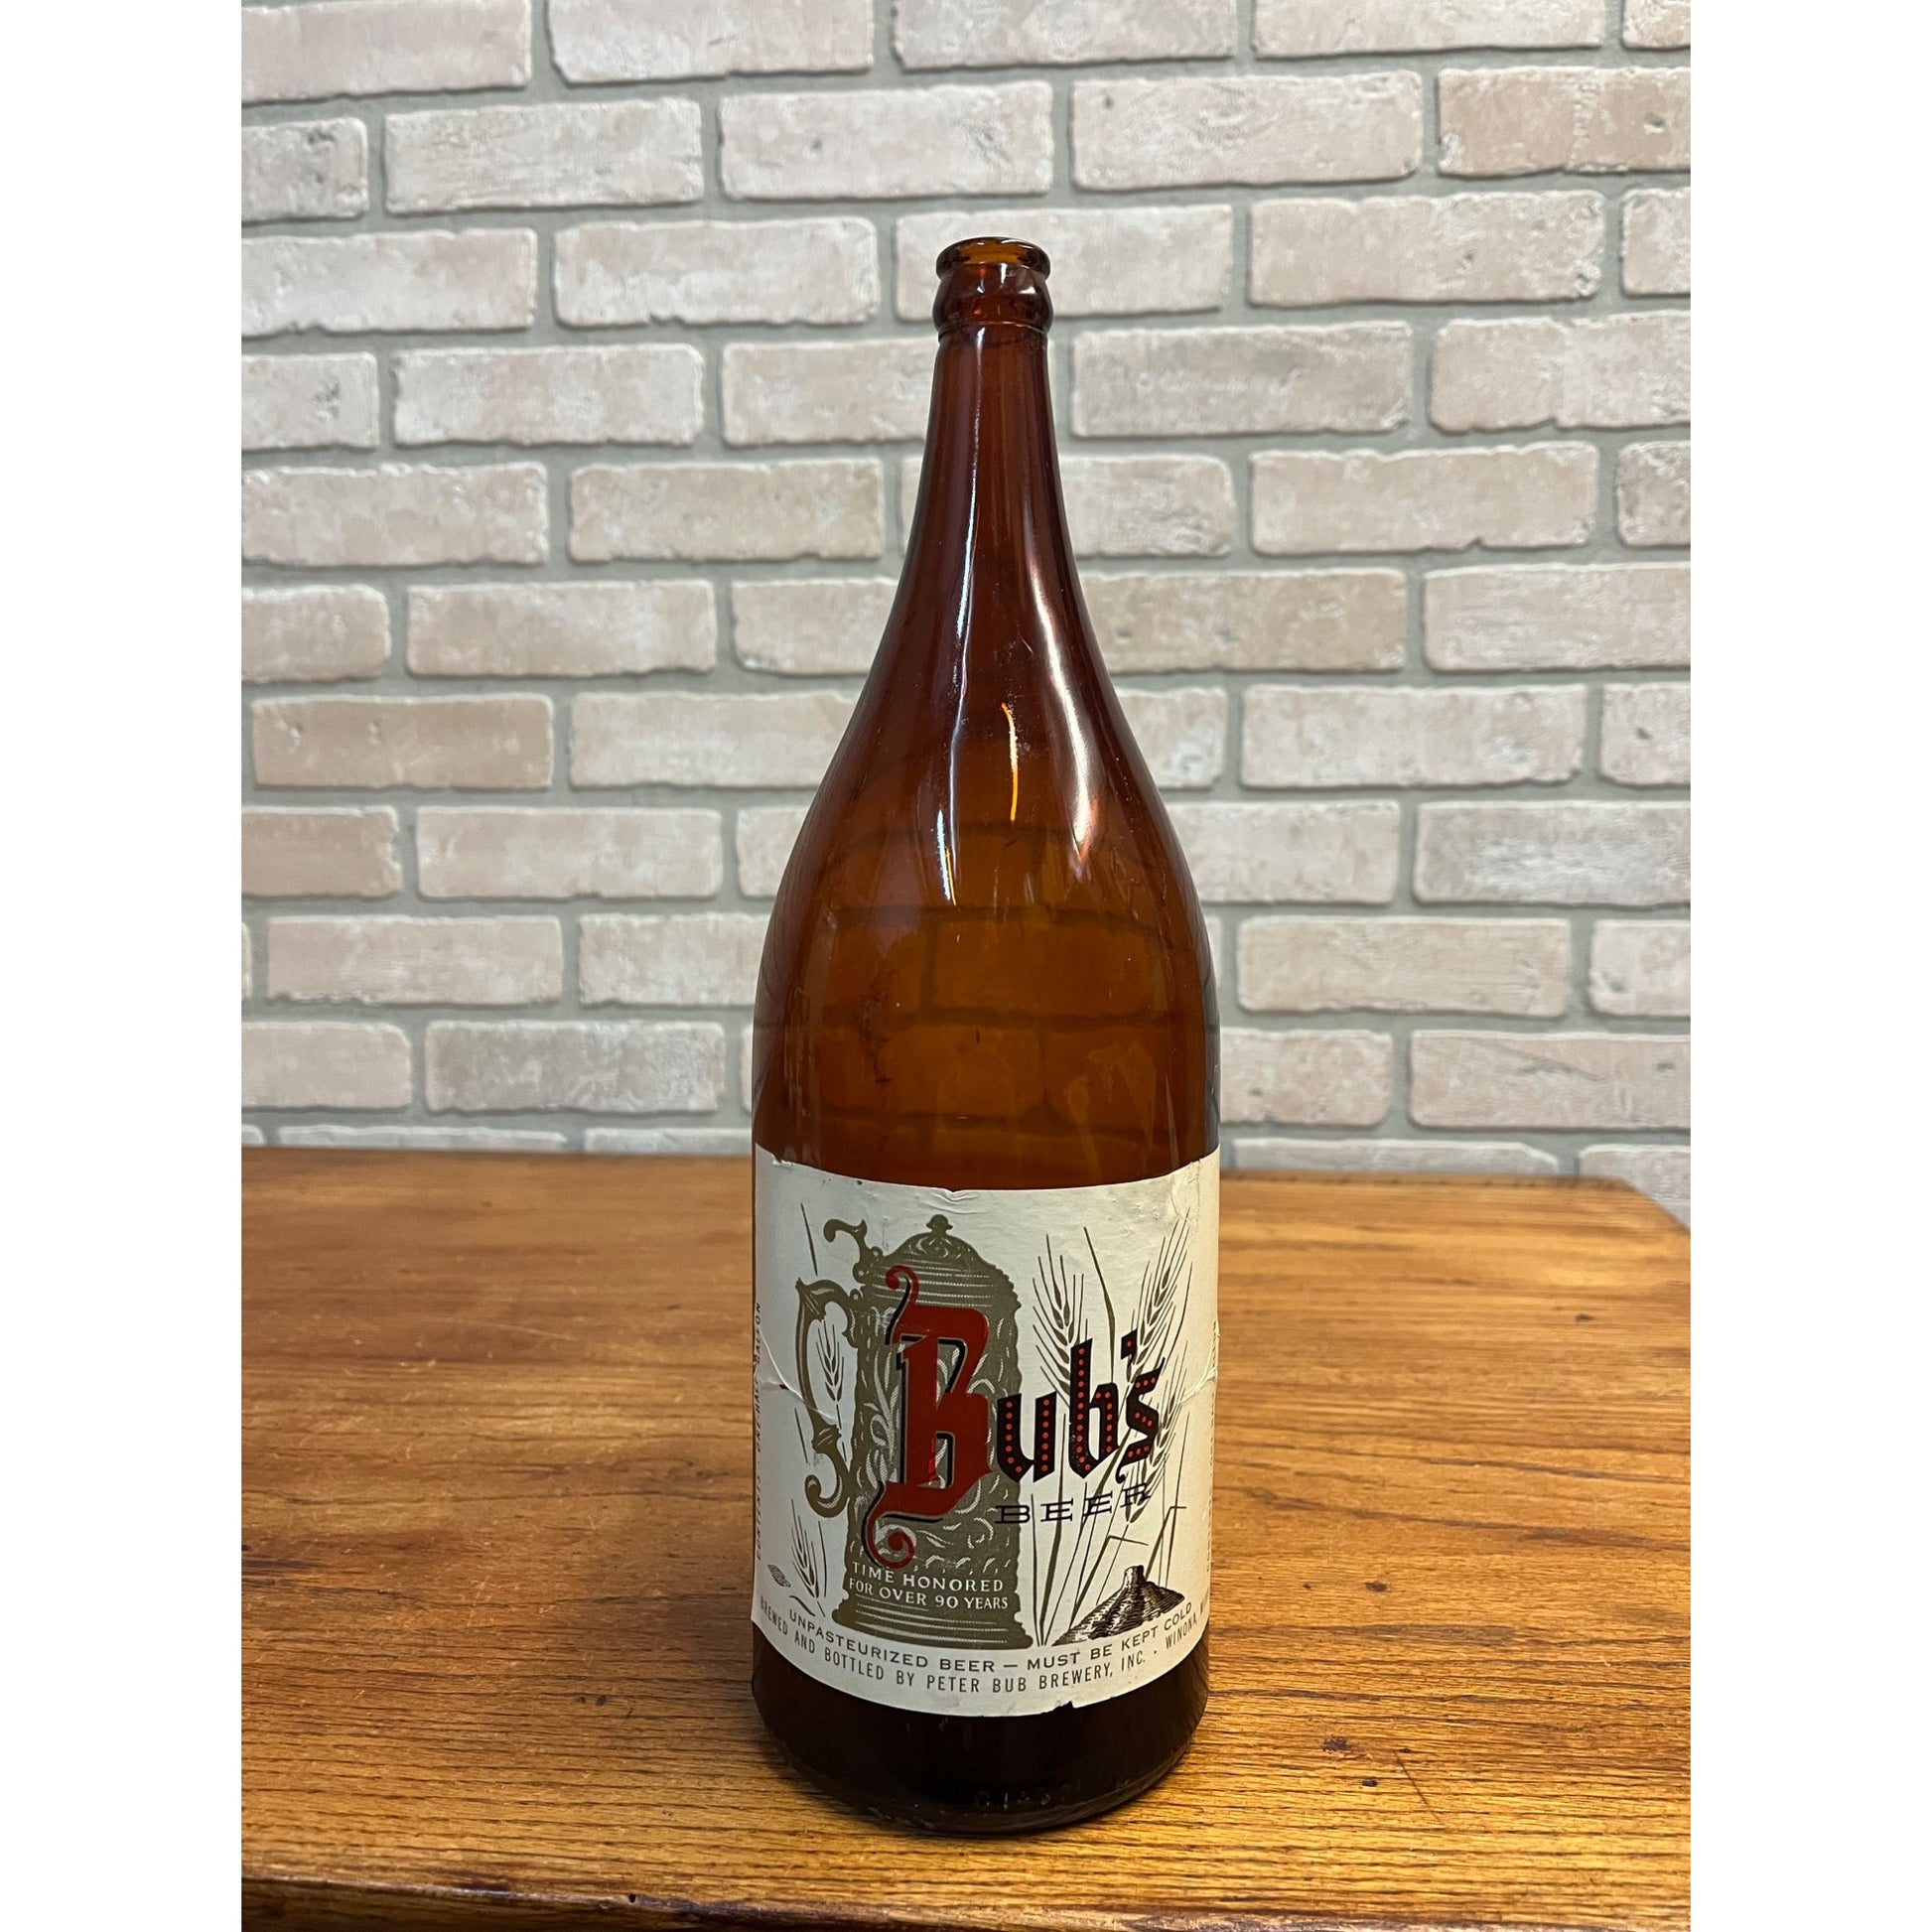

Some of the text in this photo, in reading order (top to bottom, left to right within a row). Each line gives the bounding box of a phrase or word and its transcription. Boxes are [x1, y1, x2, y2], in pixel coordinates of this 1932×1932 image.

[994, 1482, 1152, 1524] BEER
[849, 1578, 1009, 1610] FOR OVER 90 YEARS
[852, 1561, 1004, 1592] TIME HONORED
[759, 1594, 788, 1636] BREWED
[794, 1634, 815, 1654] AND
[824, 1646, 885, 1681] BOTTLED
[897, 1670, 915, 1687] BY
[926, 1674, 980, 1693] PETER
[993, 1677, 1027, 1693] BUB
[1038, 1662, 1113, 1689] BREWERY,
[1121, 1650, 1146, 1672] INC.
[789, 1608, 928, 1668] UNPASTEURIZED
[939, 1658, 995, 1673] BEER
[1027, 1651, 1081, 1671] MUST
[1090, 1643, 1113, 1660] BE
[1121, 1625, 1159, 1652] KEPT
[1164, 1601, 1192, 1631] COLD
